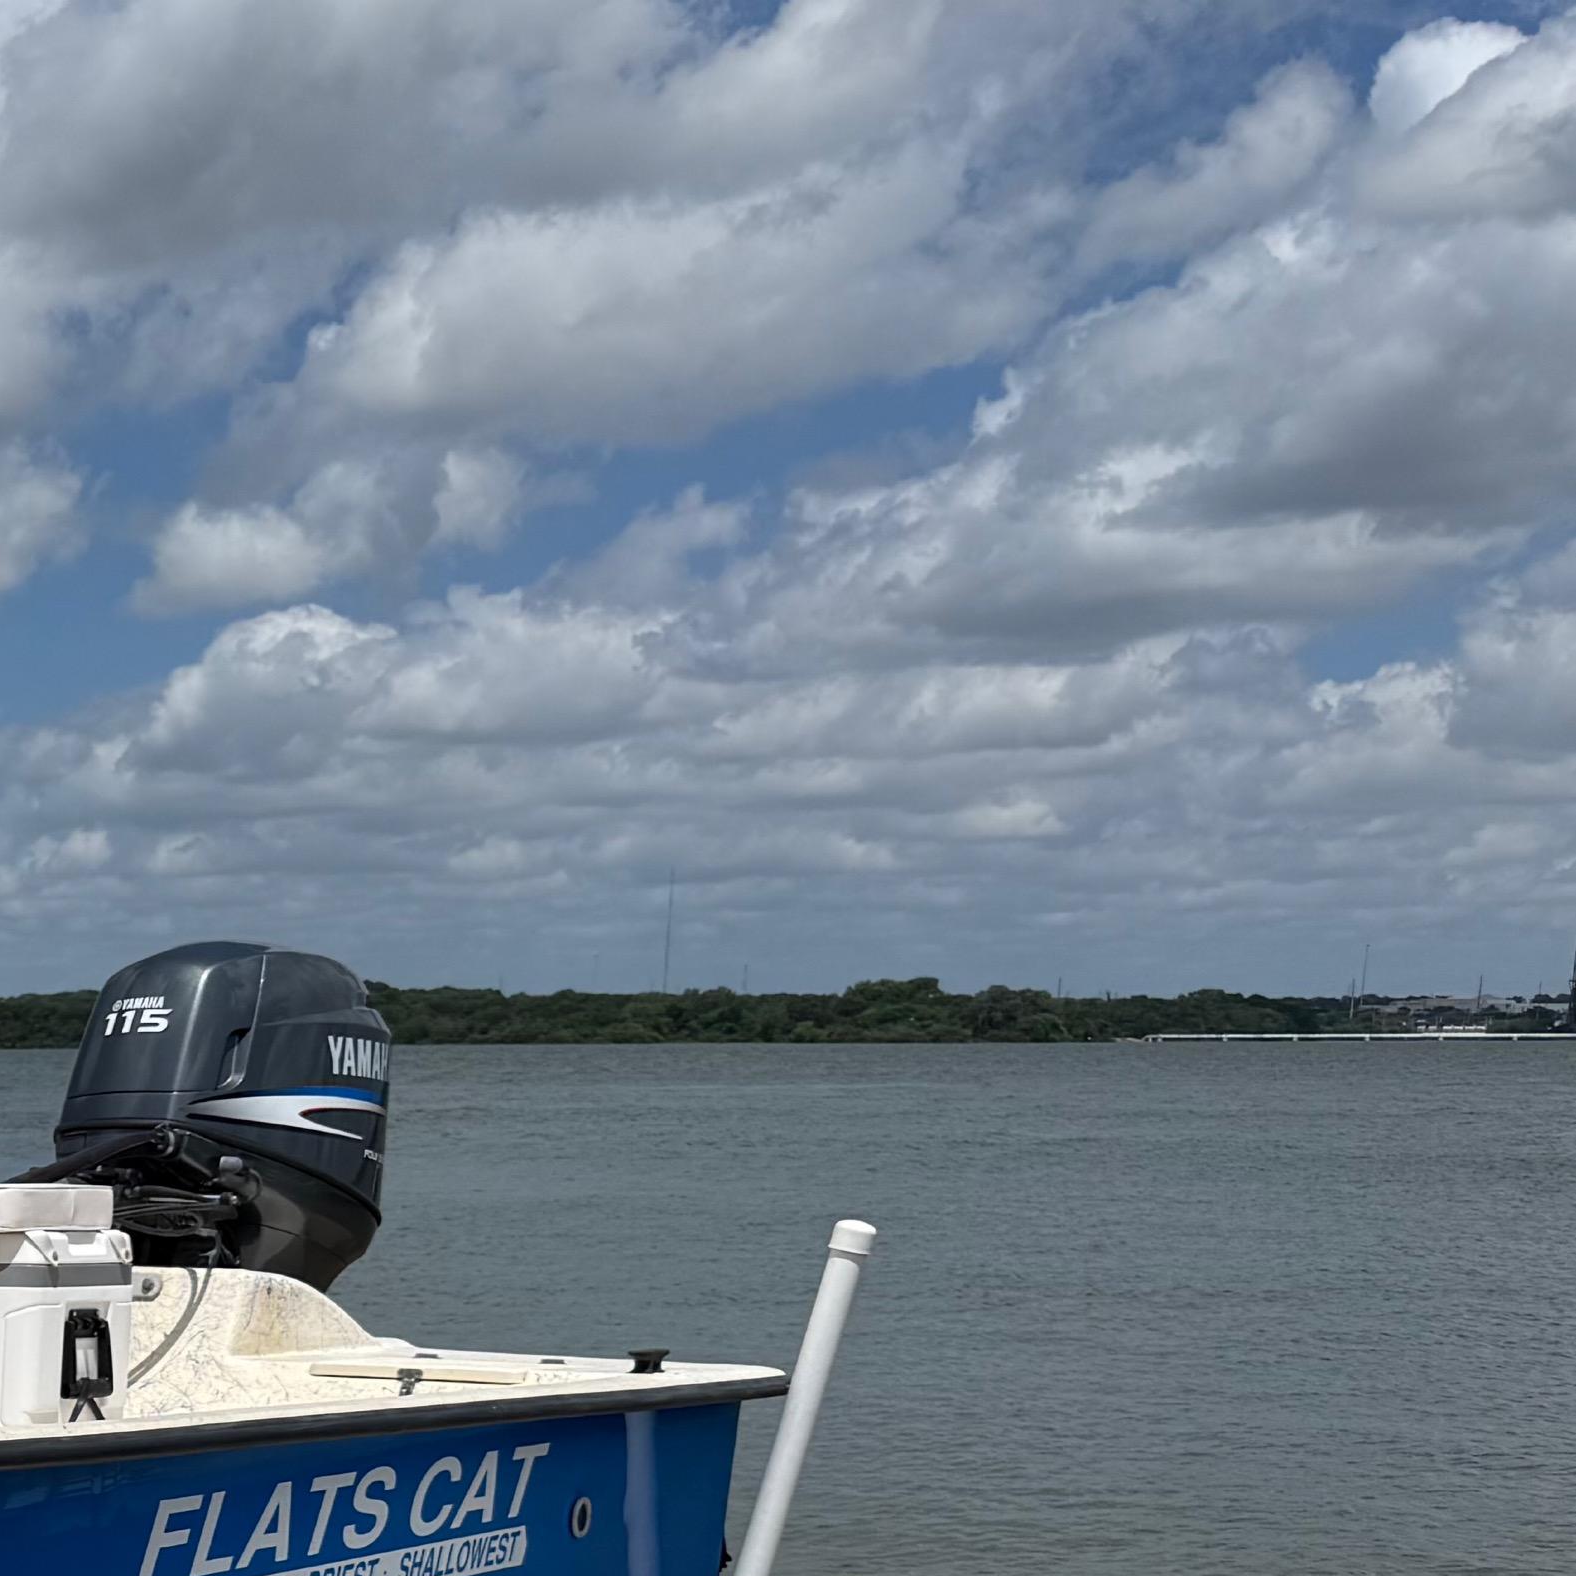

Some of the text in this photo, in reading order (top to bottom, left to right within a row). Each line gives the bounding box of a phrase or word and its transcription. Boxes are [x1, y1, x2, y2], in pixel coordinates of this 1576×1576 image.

[122, 996, 165, 1010] YAMAHA
[104, 1008, 173, 1036] 115
[409, 1443, 550, 1537] CAT
